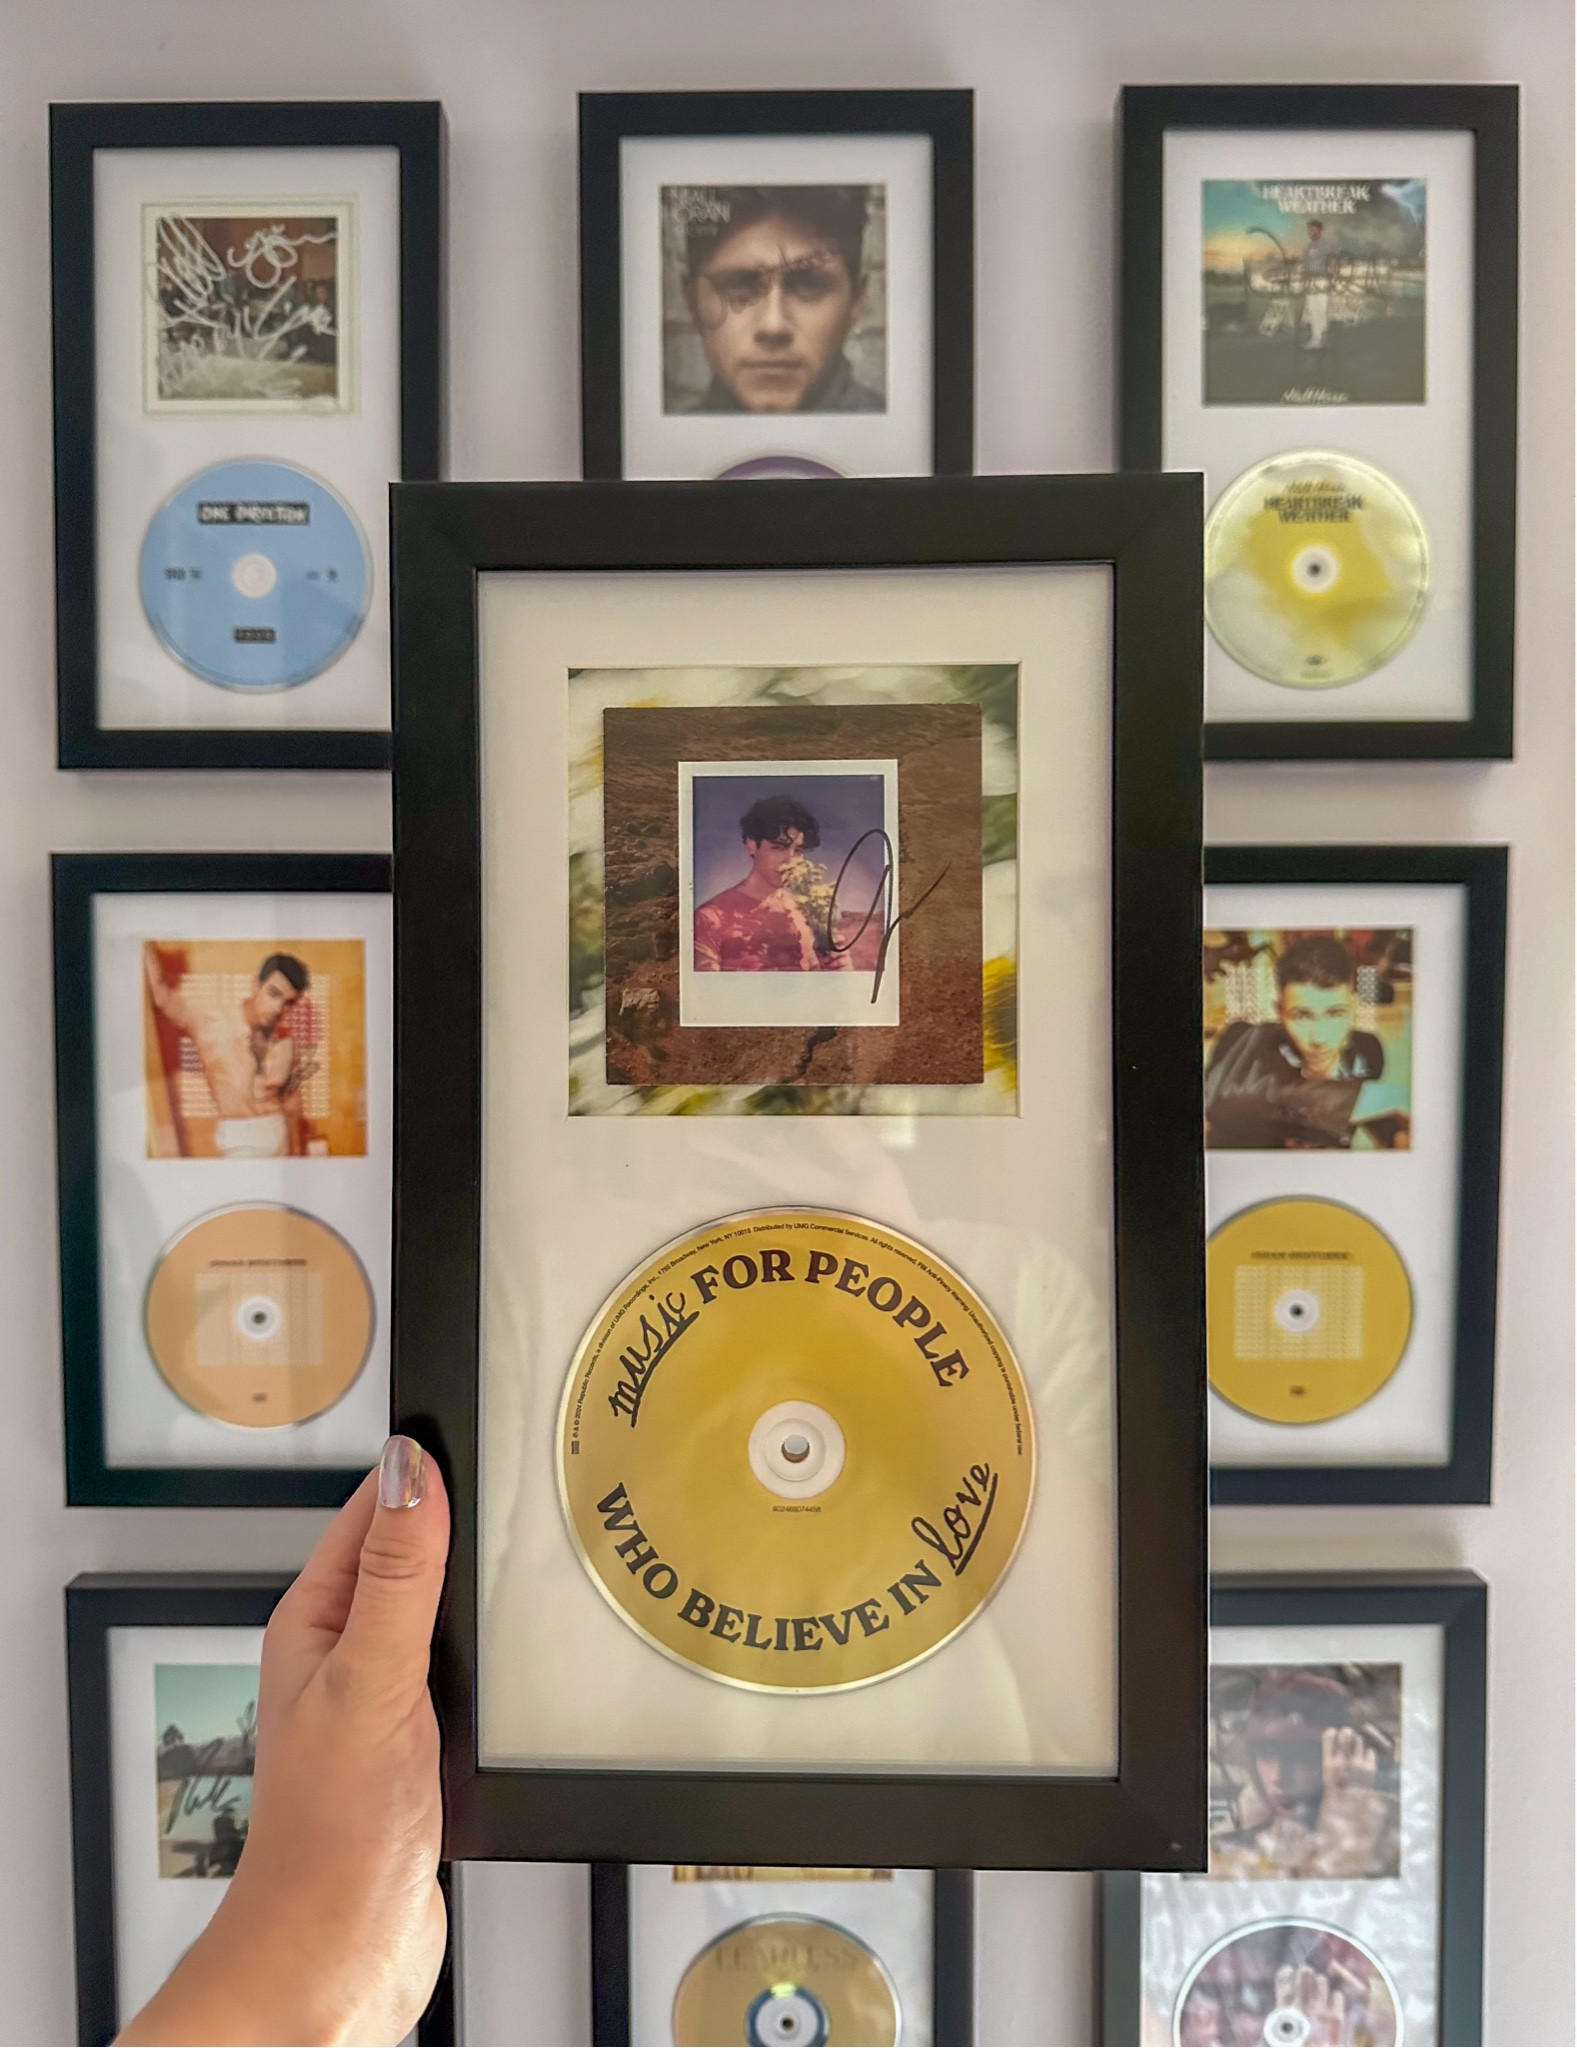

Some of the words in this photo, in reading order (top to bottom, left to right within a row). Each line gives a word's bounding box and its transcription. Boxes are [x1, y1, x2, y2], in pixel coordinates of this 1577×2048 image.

[577, 1378, 590, 1404] Republic
[584, 1352, 600, 1378] Records,
[597, 1327, 612, 1348] division
[612, 1308, 625, 1322] UMG
[622, 1282, 650, 1310] Recordings,
[696, 1242, 709, 1252] New
[709, 1236, 724, 1247] York,
[753, 1224, 784, 1233] Distributed
[810, 1224, 843, 1233] Commercial
[877, 1240, 894, 1252] rights
[916, 1261, 927, 1271] FBI
[925, 1268, 952, 1292] Anti-Piracy
[968, 1310, 993, 1345] Unauthorized
[989, 1344, 1004, 1367] copying
[1002, 1372, 1016, 1404] punishable
[608, 1291, 700, 1428] music
[690, 1249, 796, 1305] FOR
[804, 1249, 970, 1387] PEOPLE
[596, 1481, 679, 1600] WHO
[911, 1462, 999, 1577] love
[677, 1587, 890, 1652] BELIEVE
[887, 1559, 942, 1616] IN
